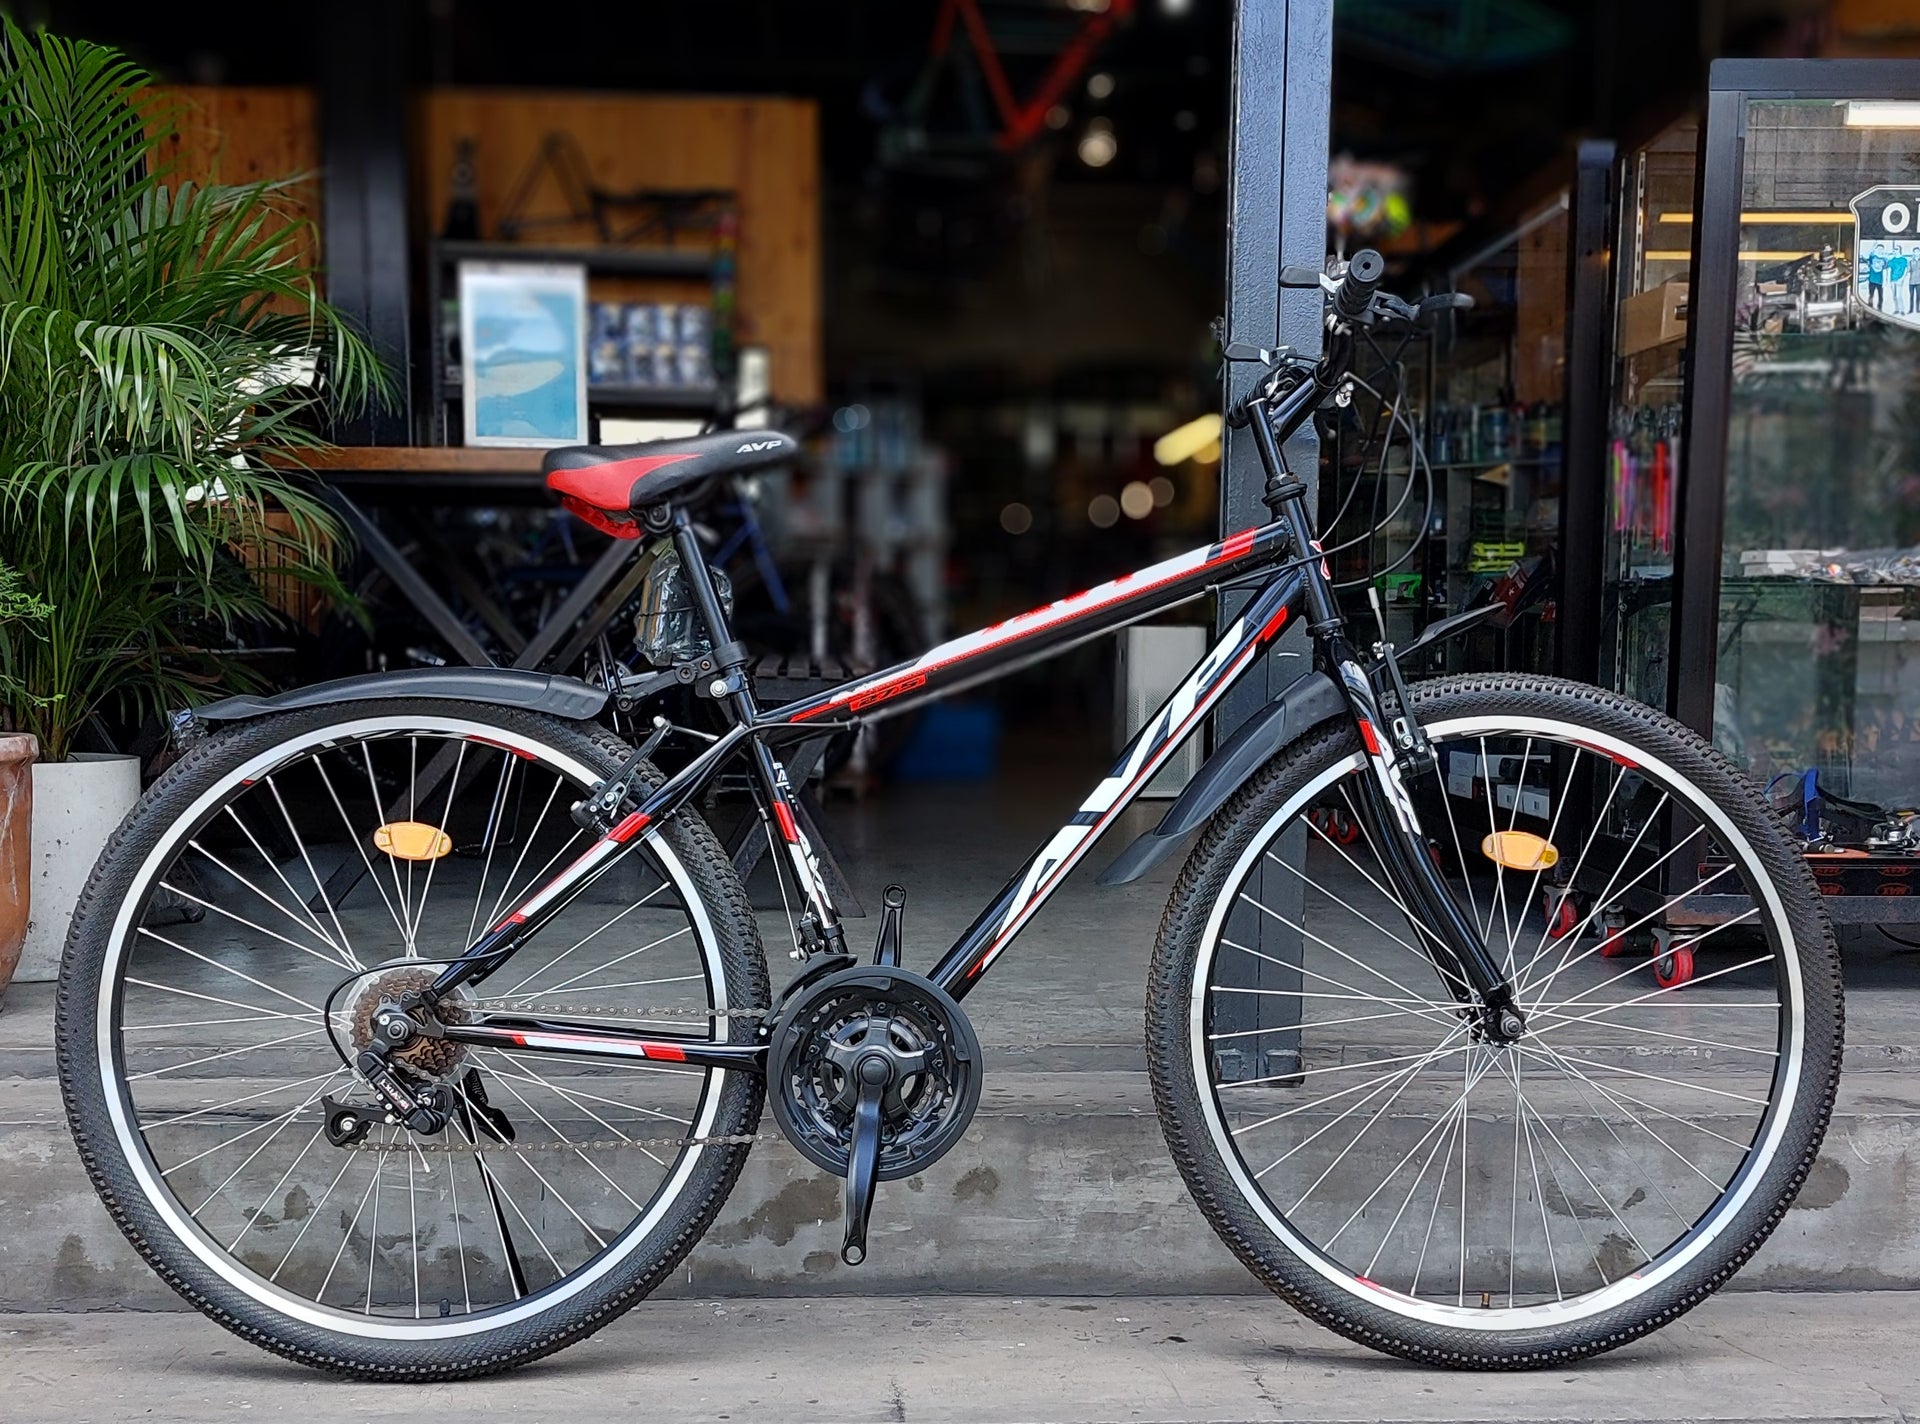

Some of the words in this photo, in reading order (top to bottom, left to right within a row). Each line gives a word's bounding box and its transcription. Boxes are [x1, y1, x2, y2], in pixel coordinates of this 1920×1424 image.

[1881, 200, 1920, 233] O
[736, 440, 783, 454] AVP
[997, 618, 1245, 940] AVP
